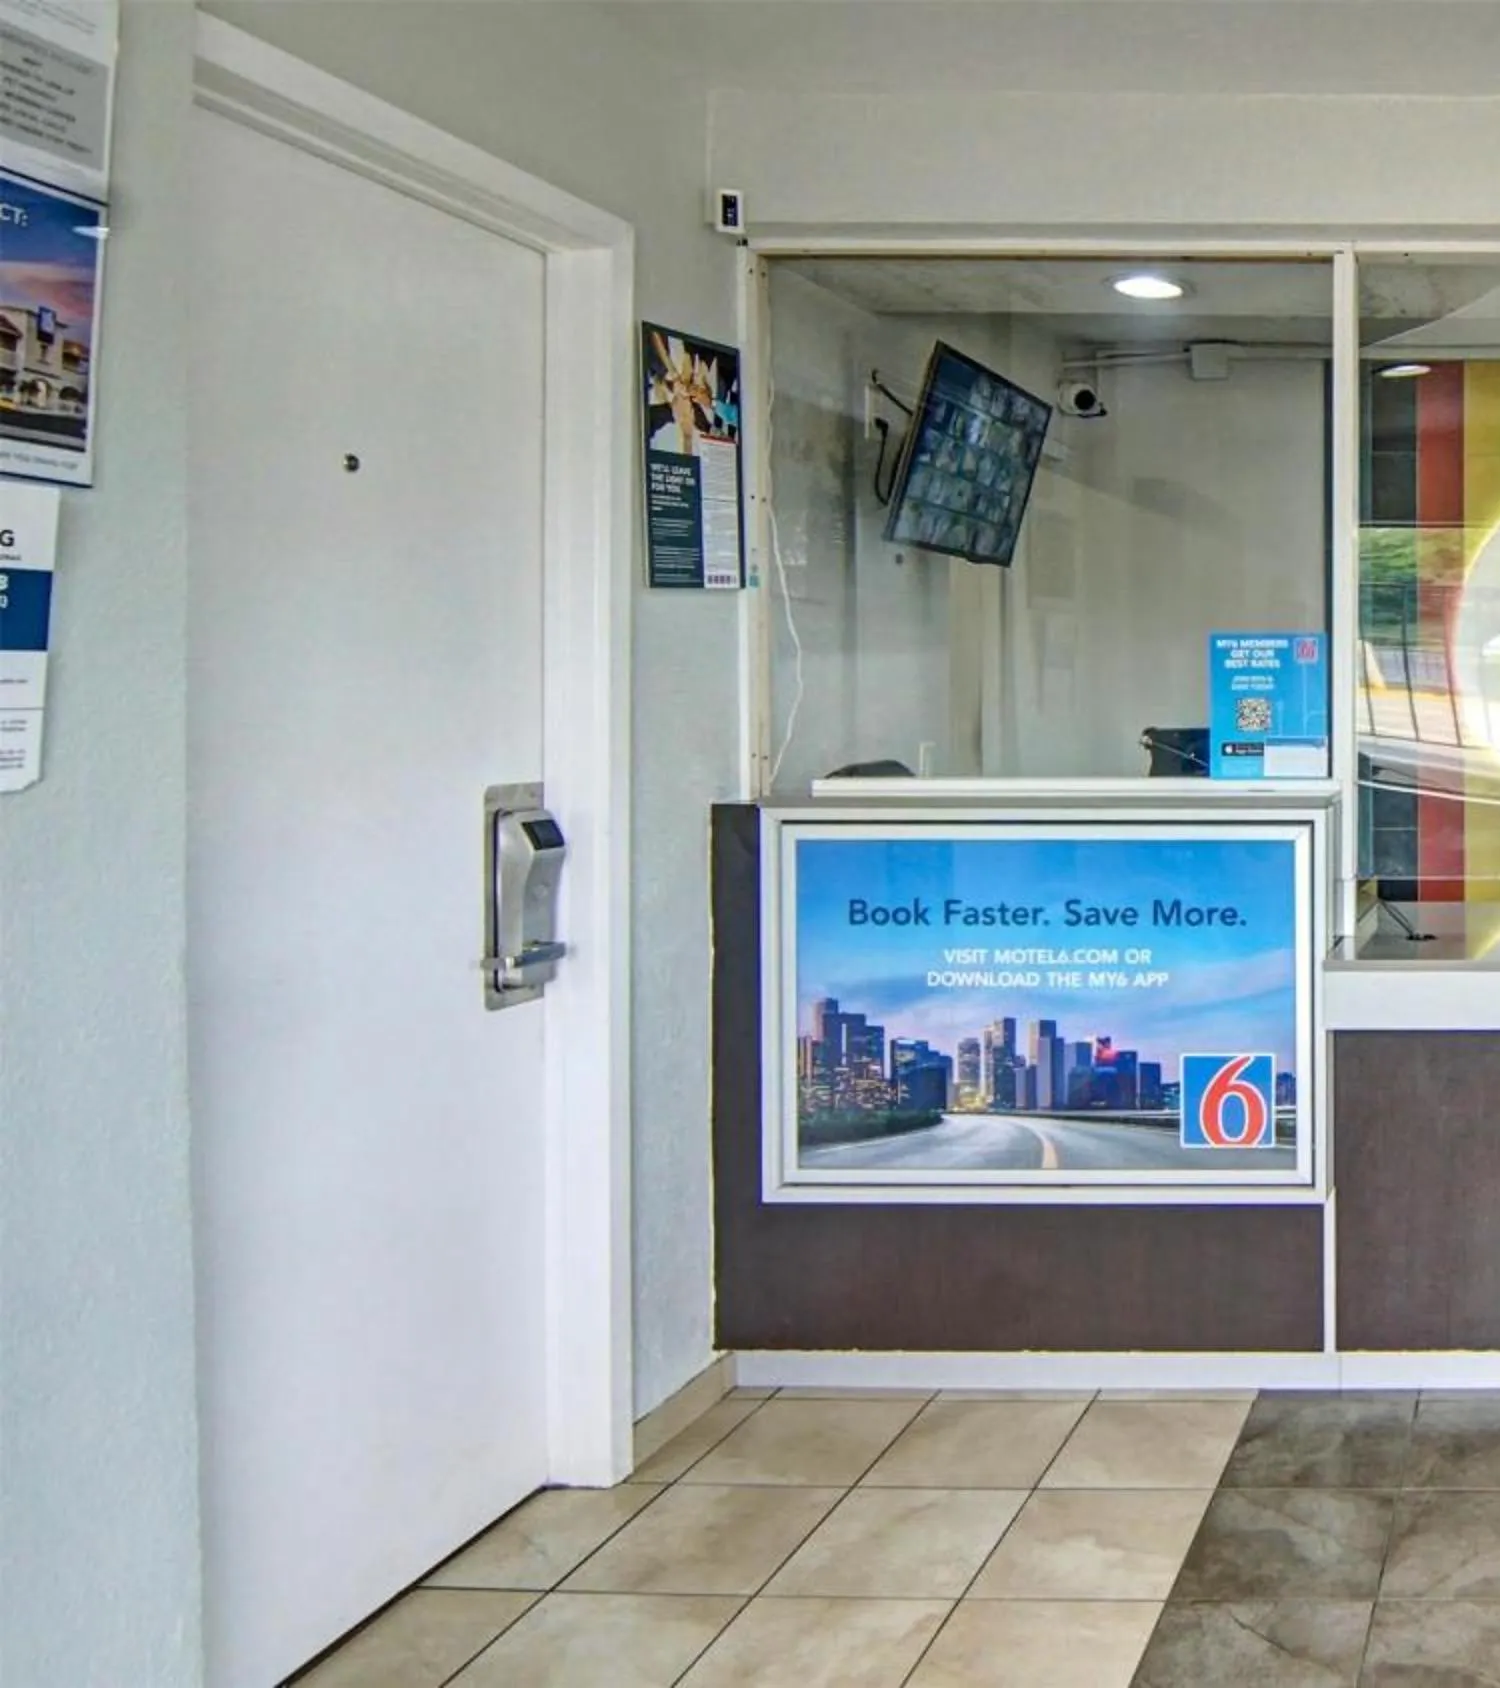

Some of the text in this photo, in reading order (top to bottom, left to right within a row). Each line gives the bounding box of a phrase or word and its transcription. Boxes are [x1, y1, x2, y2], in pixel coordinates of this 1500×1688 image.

[848, 897, 1248, 927] Book Faster. Save More.
[943, 949, 1153, 965] VISIT MOTEL6.COM OR
[926, 971, 1170, 988] DOWNLOAD THE MY6 APP
[1199, 1054, 1269, 1147] 6
